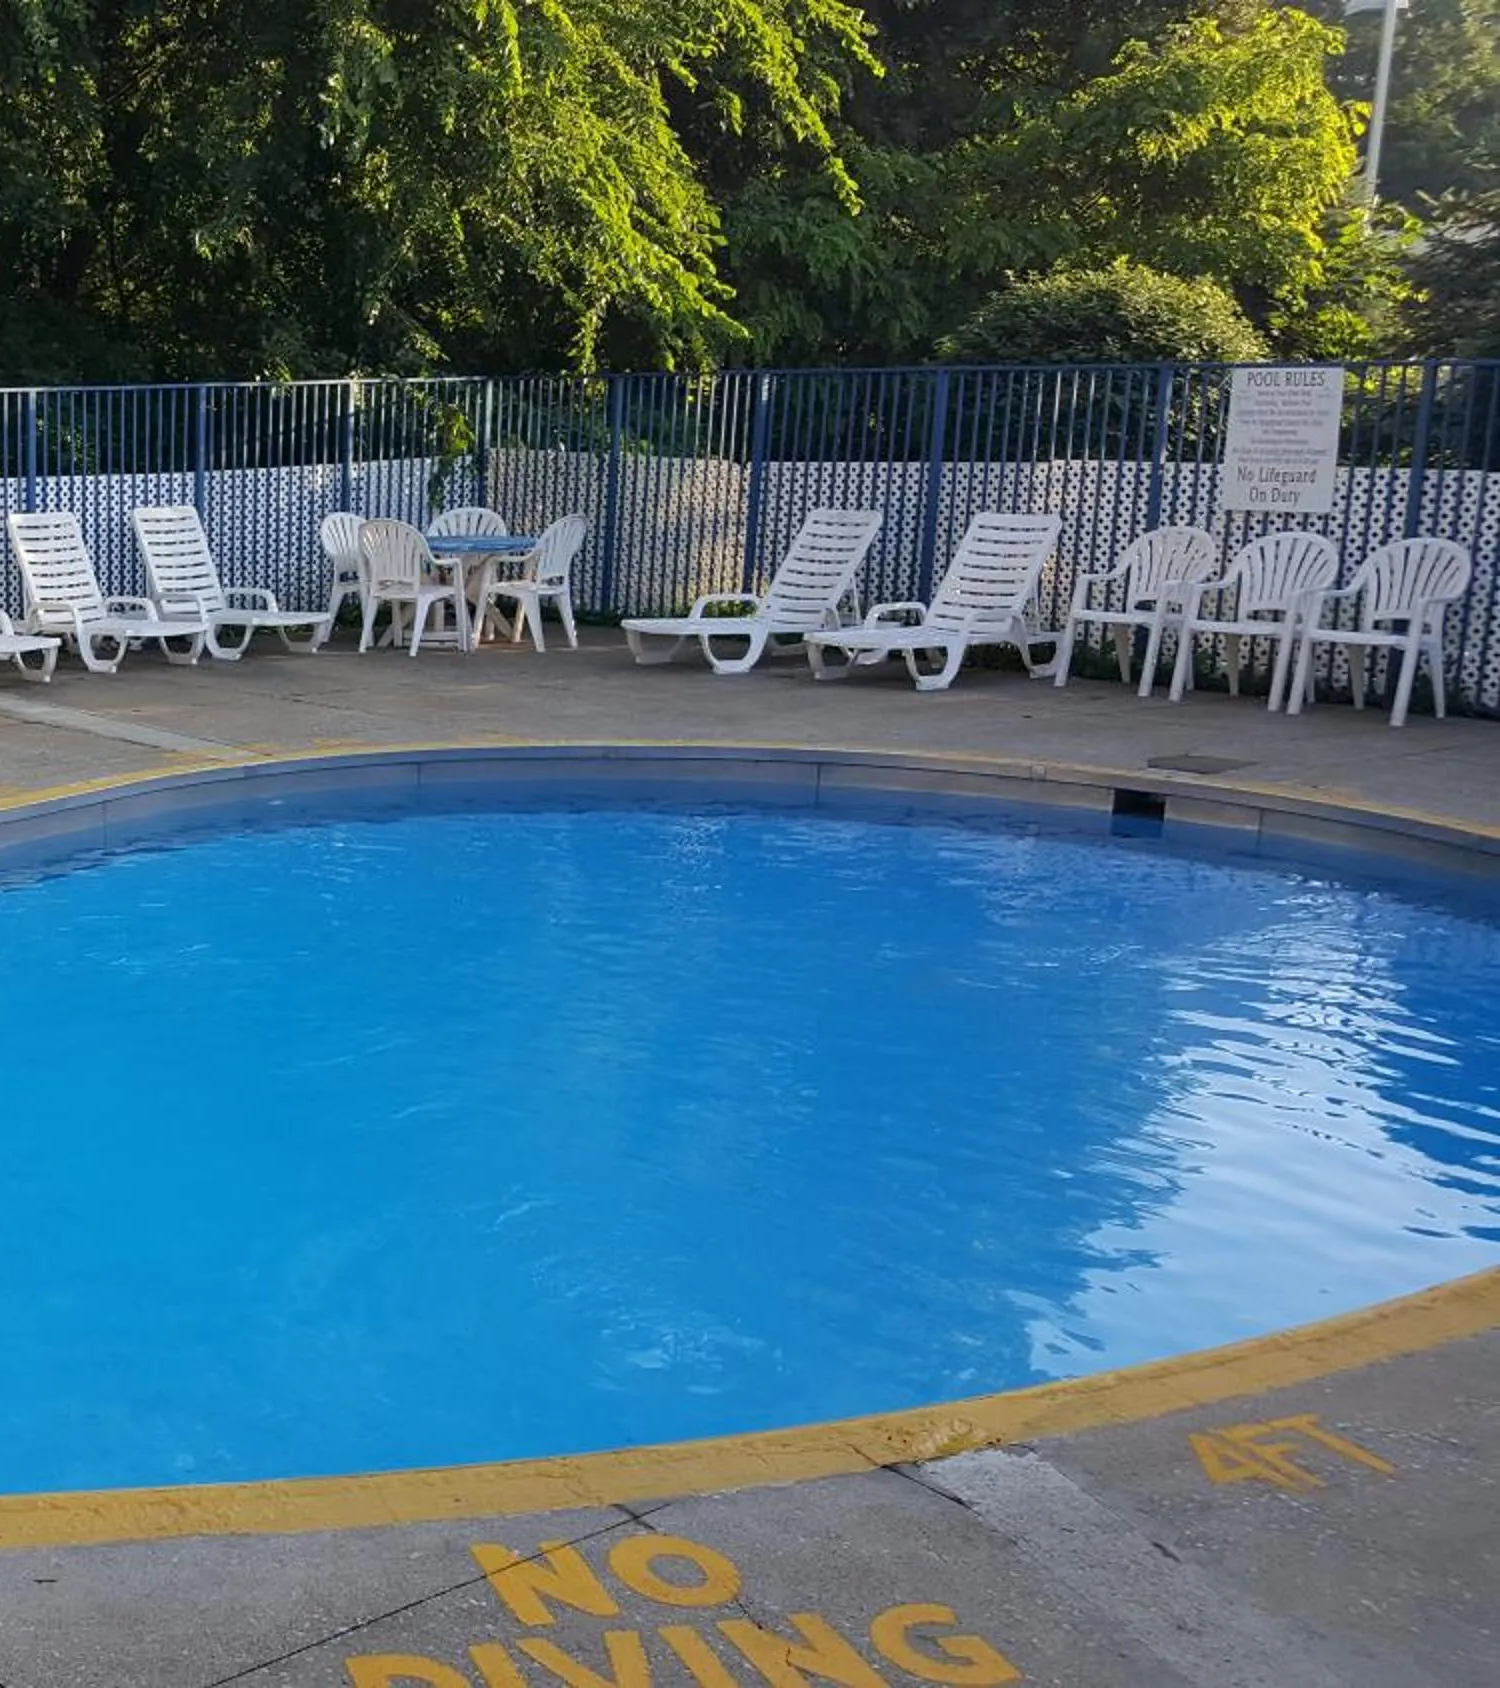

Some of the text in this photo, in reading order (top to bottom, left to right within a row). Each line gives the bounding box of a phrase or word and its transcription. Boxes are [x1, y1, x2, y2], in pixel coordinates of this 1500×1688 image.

[1247, 371, 1325, 387] POOL RULES
[1237, 466, 1317, 486] No Lifeguard
[1250, 487, 1300, 506] On Duty
[1187, 1411, 1397, 1496] 4FT
[469, 1532, 742, 1627] NO
